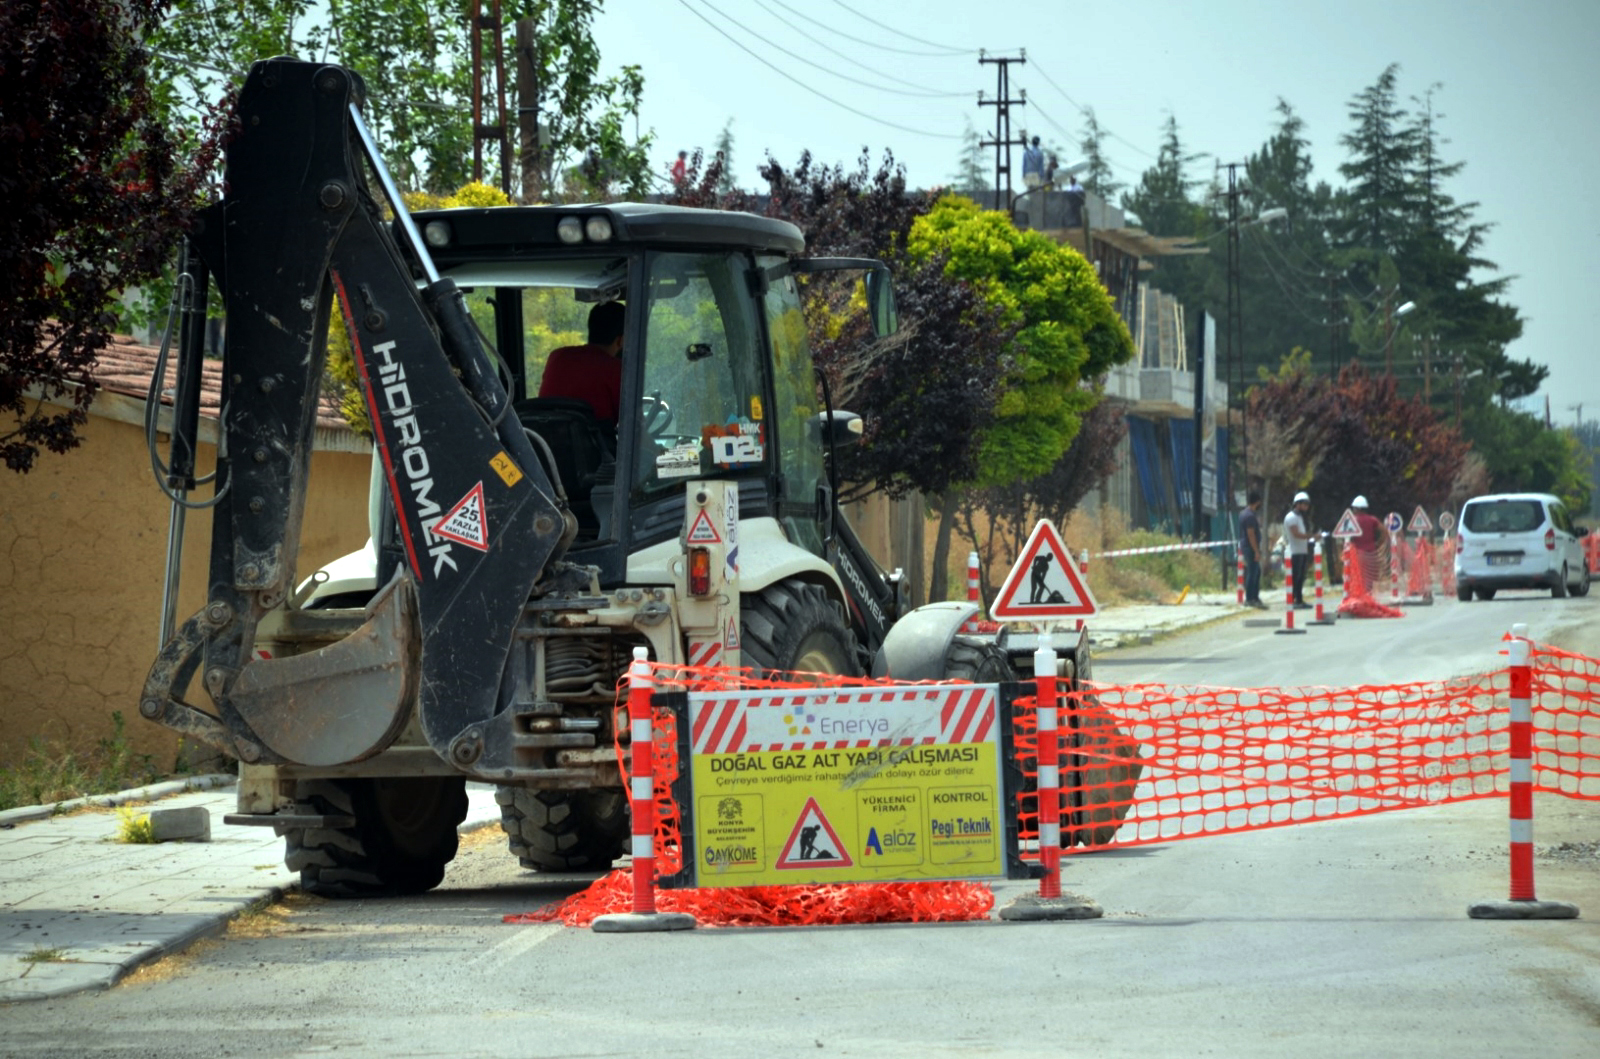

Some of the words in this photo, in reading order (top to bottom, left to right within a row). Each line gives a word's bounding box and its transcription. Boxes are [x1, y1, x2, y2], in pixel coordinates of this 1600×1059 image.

[738, 423, 761, 434] HMK
[451, 517, 480, 534] FAZLA
[820, 715, 890, 737] Enerya
[710, 753, 767, 773] DOĞAL
[772, 754, 806, 770] GAZ
[812, 753, 841, 768] ALT
[845, 751, 883, 767] YAPI
[888, 747, 979, 768] ÇALIŞMASI
[716, 776, 759, 788] Çevreye
[761, 773, 812, 785] verdiğimiz
[885, 769, 917, 779] dolayı
[918, 768, 942, 777] özür
[943, 766, 974, 776] dileriz
[862, 795, 916, 805] YÜKLENİCİ
[933, 792, 988, 804] KONTROL
[872, 804, 907, 813] FİRMA
[931, 818, 955, 838] Pegi
[956, 817, 992, 834] Teknik
[883, 828, 917, 847] alöz
[715, 846, 757, 862] AYKOME
